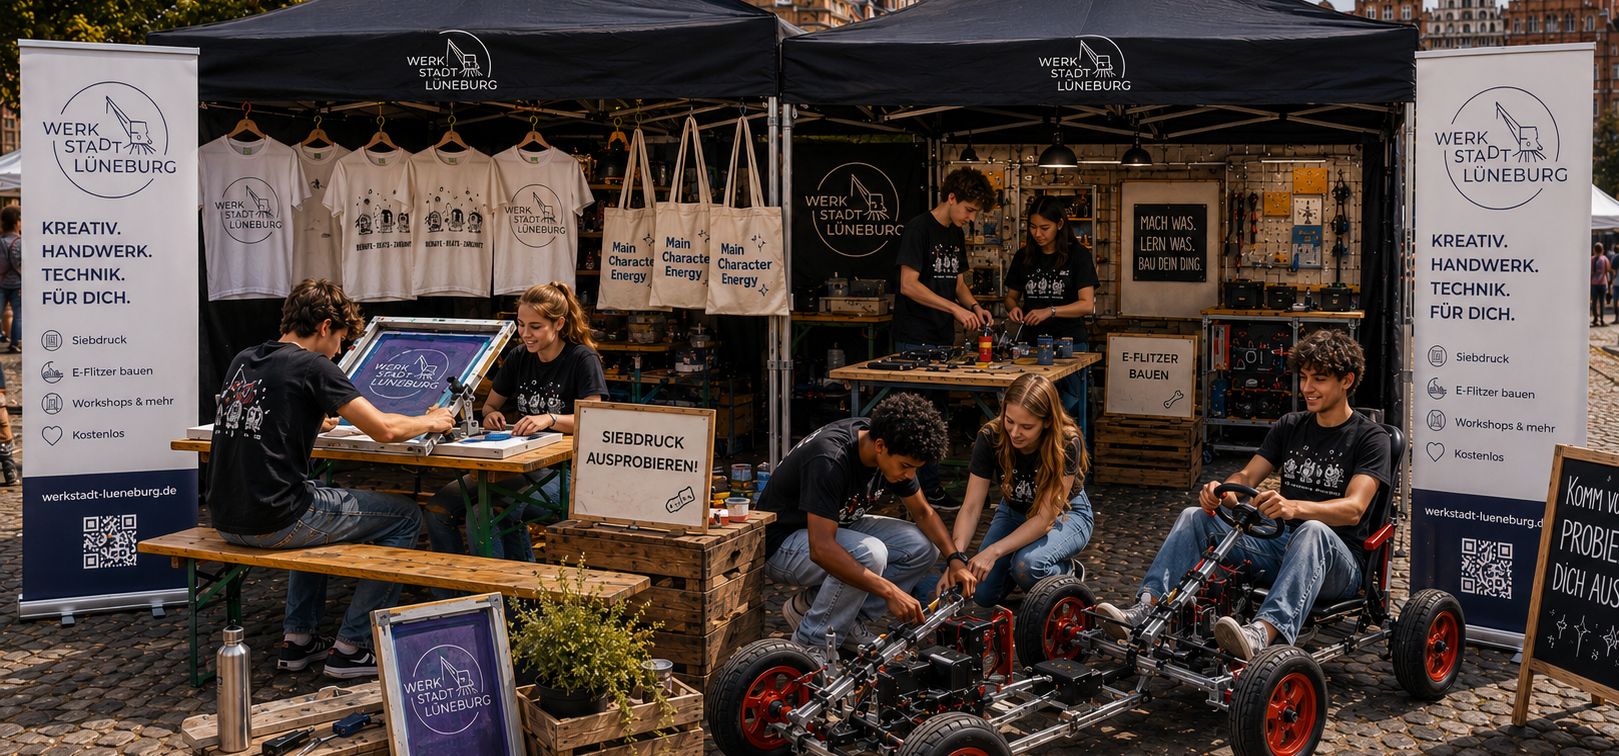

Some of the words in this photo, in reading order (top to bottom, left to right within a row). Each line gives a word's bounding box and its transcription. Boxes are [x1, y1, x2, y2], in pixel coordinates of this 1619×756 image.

[407, 56, 445, 66] WERK
[419, 68, 458, 77] STADT
[1051, 69, 1091, 78] STADT
[425, 78, 498, 91] LÜNEBURG
[1057, 79, 1131, 91] LÜNEBURG
[43, 121, 99, 136] WERK
[1435, 131, 1488, 145] WERK
[65, 138, 122, 154] STADT
[1454, 145, 1512, 163] STADT
[74, 156, 176, 174] LÜNEBURG
[1463, 166, 1568, 183] LÜNEBURG
[214, 201, 244, 210] WERK
[805, 195, 847, 207] WERK
[225, 210, 254, 219] STADT
[504, 206, 532, 215] WERK
[820, 209, 863, 220] STADT
[513, 215, 540, 224] STADT
[1140, 215, 1168, 231] MACH
[1171, 215, 1196, 231] WAS.
[42, 221, 121, 235] KREATIV.
[612, 241, 636, 254] Main
[666, 236, 690, 249] Main
[1140, 236, 1166, 252] LERN
[1169, 236, 1195, 252] WAS.
[1432, 234, 1508, 248] KREATIV.
[42, 244, 152, 258] HANDWERK.
[720, 243, 745, 255] Main
[608, 255, 654, 267] Characte
[662, 251, 710, 264] Characte
[717, 258, 772, 270] Character
[1138, 256, 1156, 271] BAU
[1158, 256, 1177, 271] DEIN
[1180, 256, 1203, 271] DING.
[1431, 258, 1539, 273] HANDWERK.
[41, 268, 125, 281] TECHNIK.
[611, 269, 646, 283] Energy
[665, 266, 702, 281] Energy
[722, 273, 758, 287] Energy
[42, 288, 77, 305] FÜR
[83, 291, 130, 304] DICH.
[1431, 282, 1510, 297] TECHNIK.
[1430, 303, 1463, 320] FÜR
[1469, 307, 1515, 322] DICH.
[72, 335, 127, 345] Siebdruck
[1122, 352, 1179, 364] E-FLITZER
[1456, 351, 1510, 364] Siebdruck
[72, 367, 116, 377] E-Flitzer
[119, 367, 153, 376] bauen
[1129, 369, 1169, 380] BAUEN
[1455, 386, 1499, 398] E-Flitzer
[1501, 388, 1535, 399] bauen
[72, 398, 133, 409] Workshops
[135, 398, 143, 407] &
[145, 396, 174, 406] mehr
[1455, 417, 1513, 431] Workshops
[1516, 422, 1524, 431] &
[1526, 422, 1555, 433] mehr
[72, 429, 125, 440] Kostenlos
[602, 430, 684, 450] SIEBDRUCK
[586, 452, 698, 473] AUSPROBIEREN!
[1454, 449, 1504, 462] Kostenlos
[42, 486, 177, 502] werkstadt-lueneburg.de
[1425, 507, 1544, 529] werkstadt-lueneburg.d
[1560, 519, 1619, 563] PROBIE
[403, 677, 442, 694] WERK
[417, 688, 454, 704] STADT
[425, 694, 492, 717] LÜNEBURG
